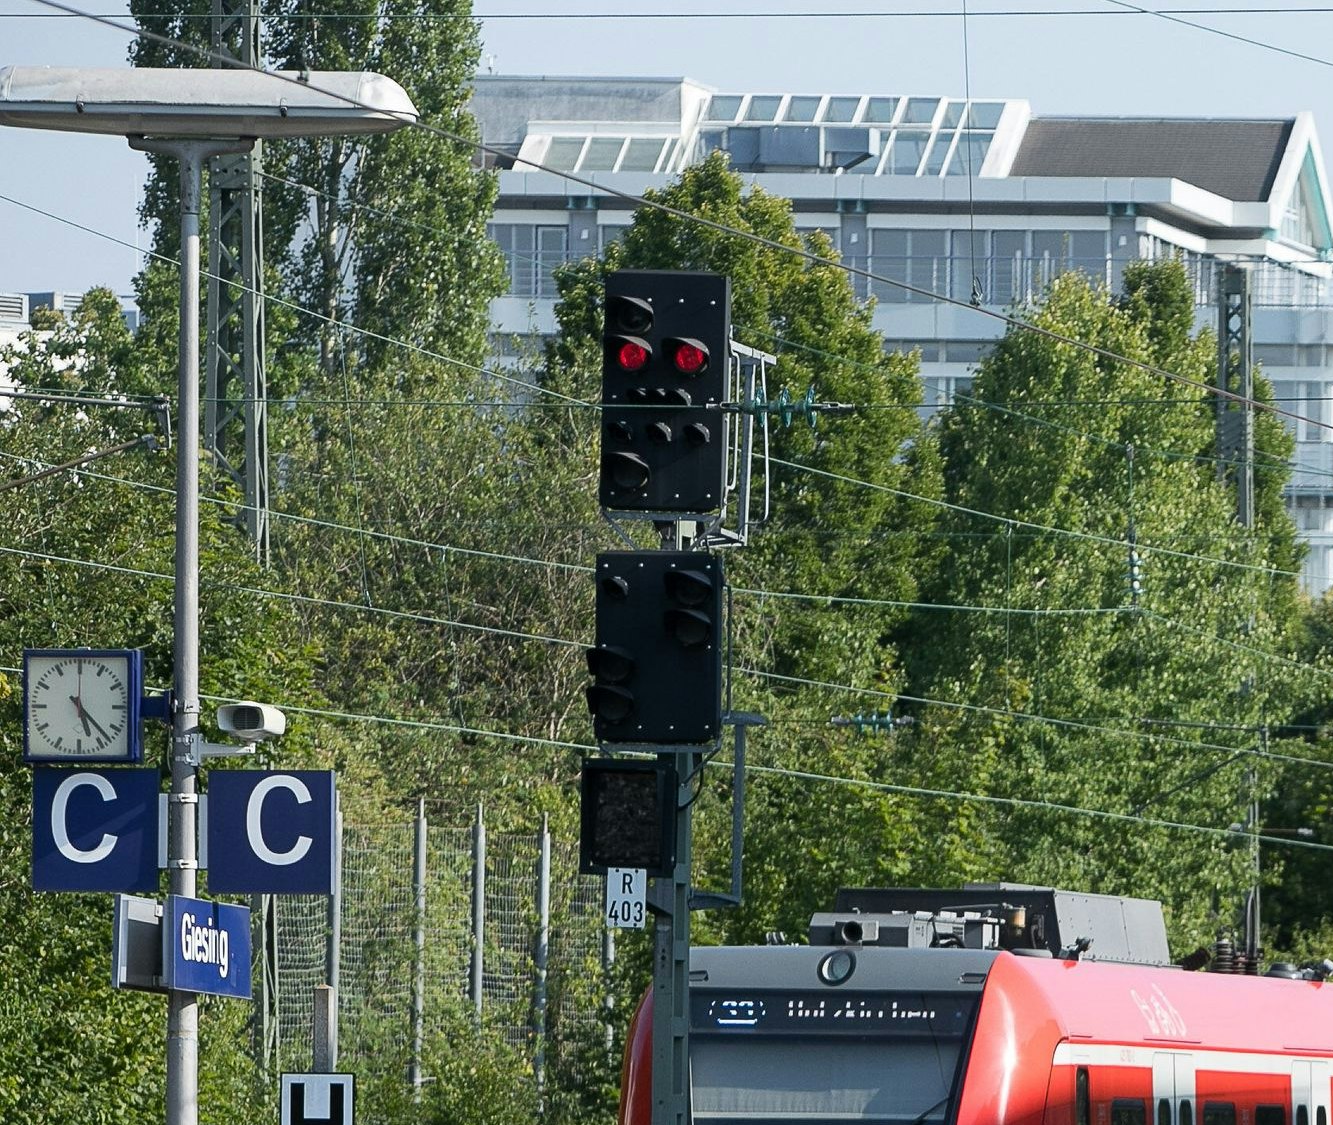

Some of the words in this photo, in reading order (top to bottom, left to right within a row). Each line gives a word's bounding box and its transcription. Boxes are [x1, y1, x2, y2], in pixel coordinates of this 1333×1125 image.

[51, 772, 118, 863] C
[246, 774, 313, 866] C
[608, 900, 643, 923] 403
[622, 873, 633, 894] R
[181, 912, 229, 978] Giesing
